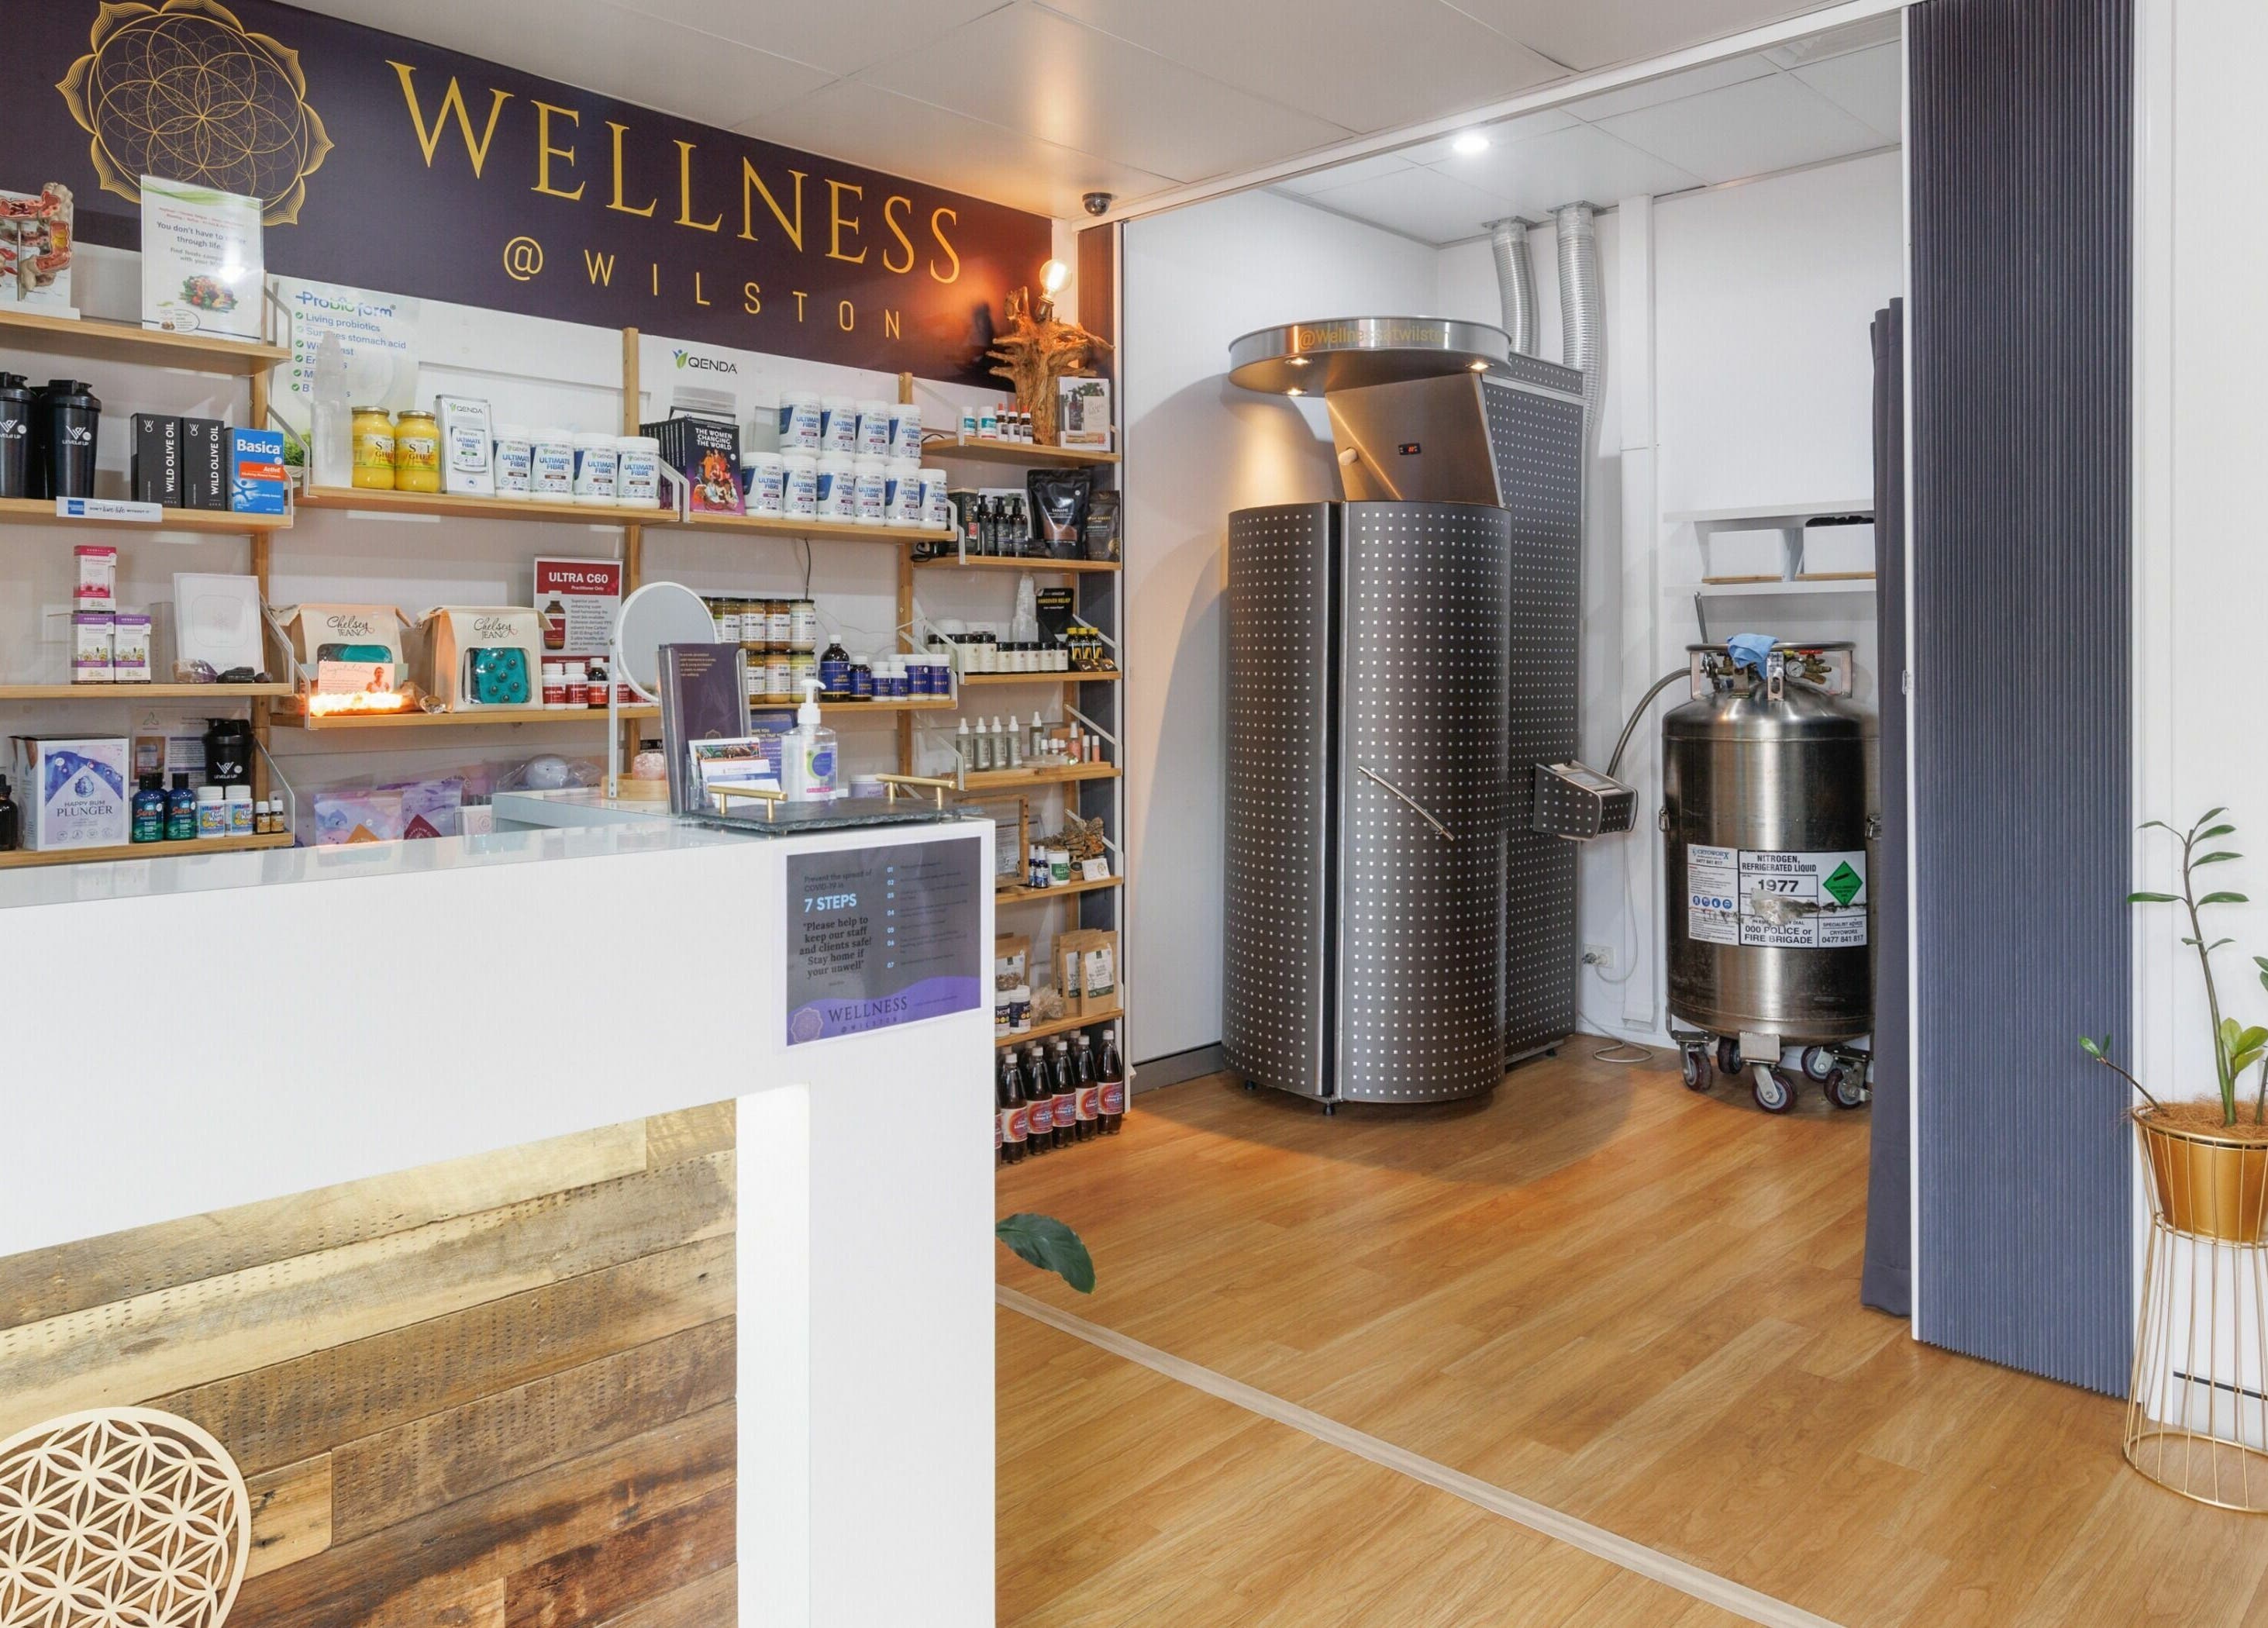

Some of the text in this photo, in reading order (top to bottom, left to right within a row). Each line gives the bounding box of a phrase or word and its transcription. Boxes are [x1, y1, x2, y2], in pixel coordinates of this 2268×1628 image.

[385, 60, 960, 284] WELLNESS
[157, 221, 171, 230] You
[173, 223, 194, 233] don't
[195, 229, 214, 238] have
[177, 236, 207, 248] through
[503, 236, 901, 340] @ WILSTON
[306, 313, 381, 333] Living probiotics
[348, 334, 386, 347] stomach
[388, 340, 406, 349] acid
[688, 357, 737, 374] QENDA
[166, 422, 174, 437] OIL
[210, 426, 219, 441] OIL
[708, 429, 732, 440] WOMEN
[698, 434, 731, 444] CHANGING
[710, 441, 732, 450] WORLD
[166, 440, 174, 466] OLIVE
[210, 443, 219, 469] OLIVE
[539, 457, 570, 465] ULTIMATE
[166, 469, 174, 492] WILD
[210, 471, 219, 495] WILD
[549, 572, 608, 584] ULTRA C60
[326, 615, 369, 634] Chelsey
[474, 616, 512, 636] Chelsey
[338, 629, 361, 637] JEAN
[481, 631, 505, 640] JEAN
[57, 805, 114, 817] PLUNGER
[1757, 855, 1800, 864] NITROGEN,
[1742, 863, 1817, 873] REFRIGERATED LIQUID
[805, 874, 829, 882] Prevent
[1758, 879, 1799, 892] 1977
[804, 893, 857, 912] 7 STEPS
[838, 917, 857, 928] help
[805, 926, 867, 943] keep our staff
[1764, 926, 1800, 935] POLICE
[799, 936, 872, 955] and clients safe!
[1744, 933, 1813, 944] FIRE BRIGADE
[808, 948, 864, 966] Stay home if
[807, 967, 829, 979] your
[829, 996, 908, 1023] WELLNESS
